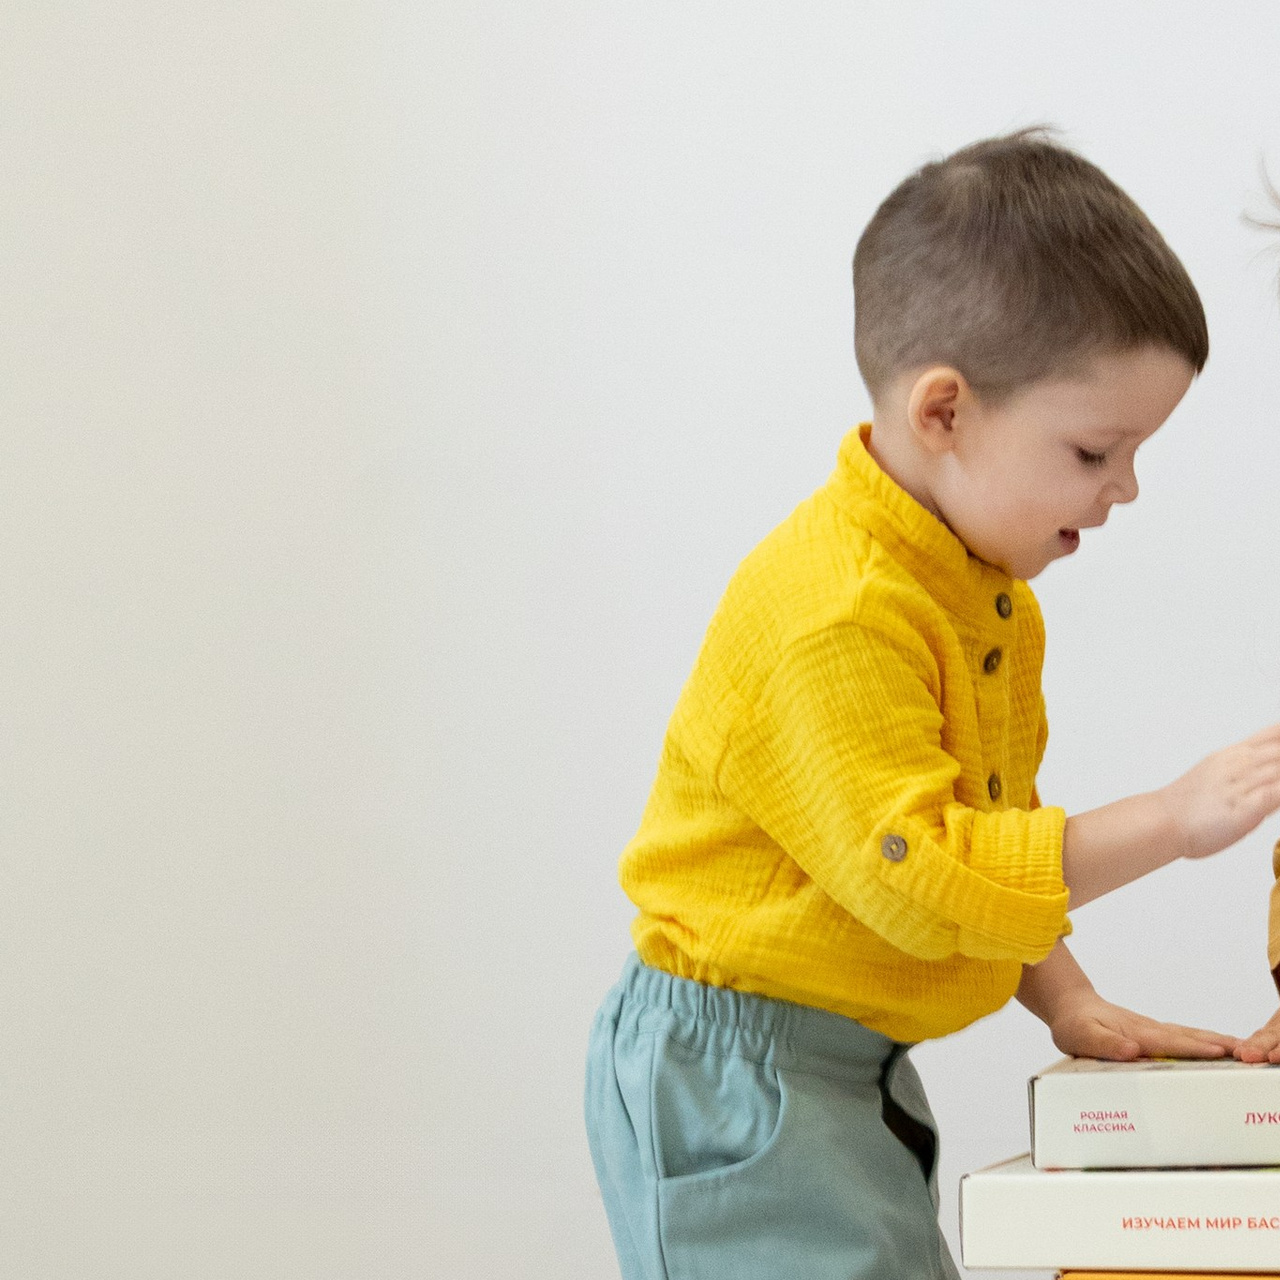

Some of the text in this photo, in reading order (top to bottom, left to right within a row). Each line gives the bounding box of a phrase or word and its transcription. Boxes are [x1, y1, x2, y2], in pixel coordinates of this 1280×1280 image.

[1080, 1110, 1128, 1122] РОДНАЯ
[1073, 1121, 1136, 1133] КЛАССИКА
[1122, 1216, 1201, 1231] ИЗУЧАЕМ
[1205, 1216, 1242, 1231] МИР
